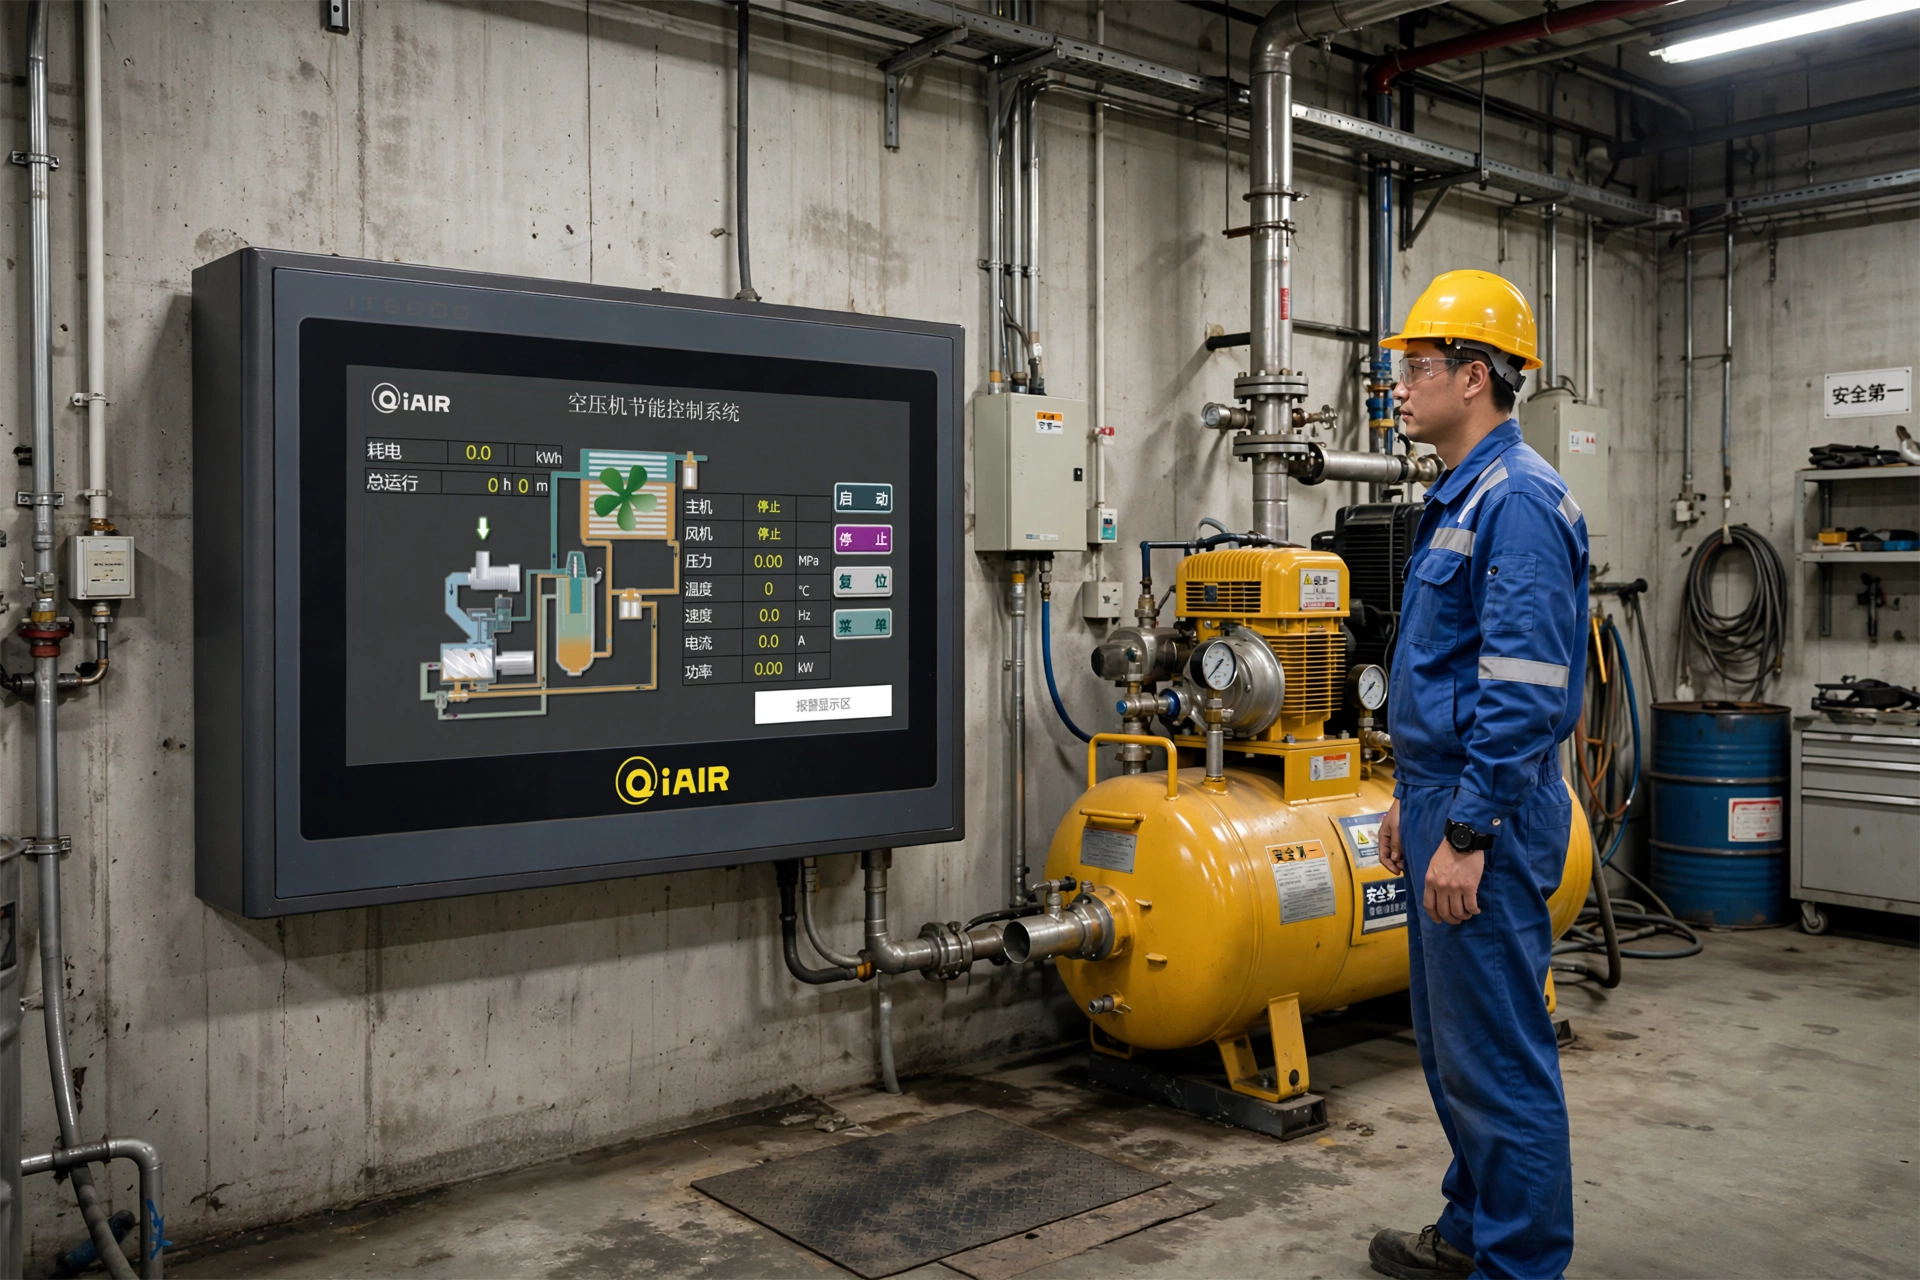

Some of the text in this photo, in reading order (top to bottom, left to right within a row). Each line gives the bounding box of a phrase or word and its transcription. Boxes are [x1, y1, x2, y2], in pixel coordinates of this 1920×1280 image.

[372, 382, 451, 413] QiAIR
[1832, 383, 1904, 405] 安全第一
[568, 392, 740, 422] 空压机节能控制系统
[367, 441, 402, 460] 耗电
[466, 444, 491, 461] 0.0
[536, 451, 562, 465] kWh
[367, 472, 419, 492] 总运行
[487, 477, 548, 494] 0 h 0 m
[685, 499, 713, 515] 主机
[757, 500, 781, 513] 停止
[685, 527, 713, 541] 风机
[757, 527, 781, 541] 停止
[685, 554, 712, 569] 压力
[754, 554, 783, 568] 0.00
[798, 555, 819, 566] MPa
[685, 581, 713, 597] 温度
[764, 582, 773, 596] 0
[685, 608, 713, 624] 速度
[759, 608, 780, 622] 0.0
[798, 610, 811, 621] Hz
[685, 635, 713, 651] 电流
[758, 634, 779, 648] 0.0
[798, 635, 806, 646] A
[685, 663, 713, 679] 功率
[754, 662, 783, 676] 0.00
[798, 662, 814, 673] kW
[615, 756, 730, 805] QiAIR
